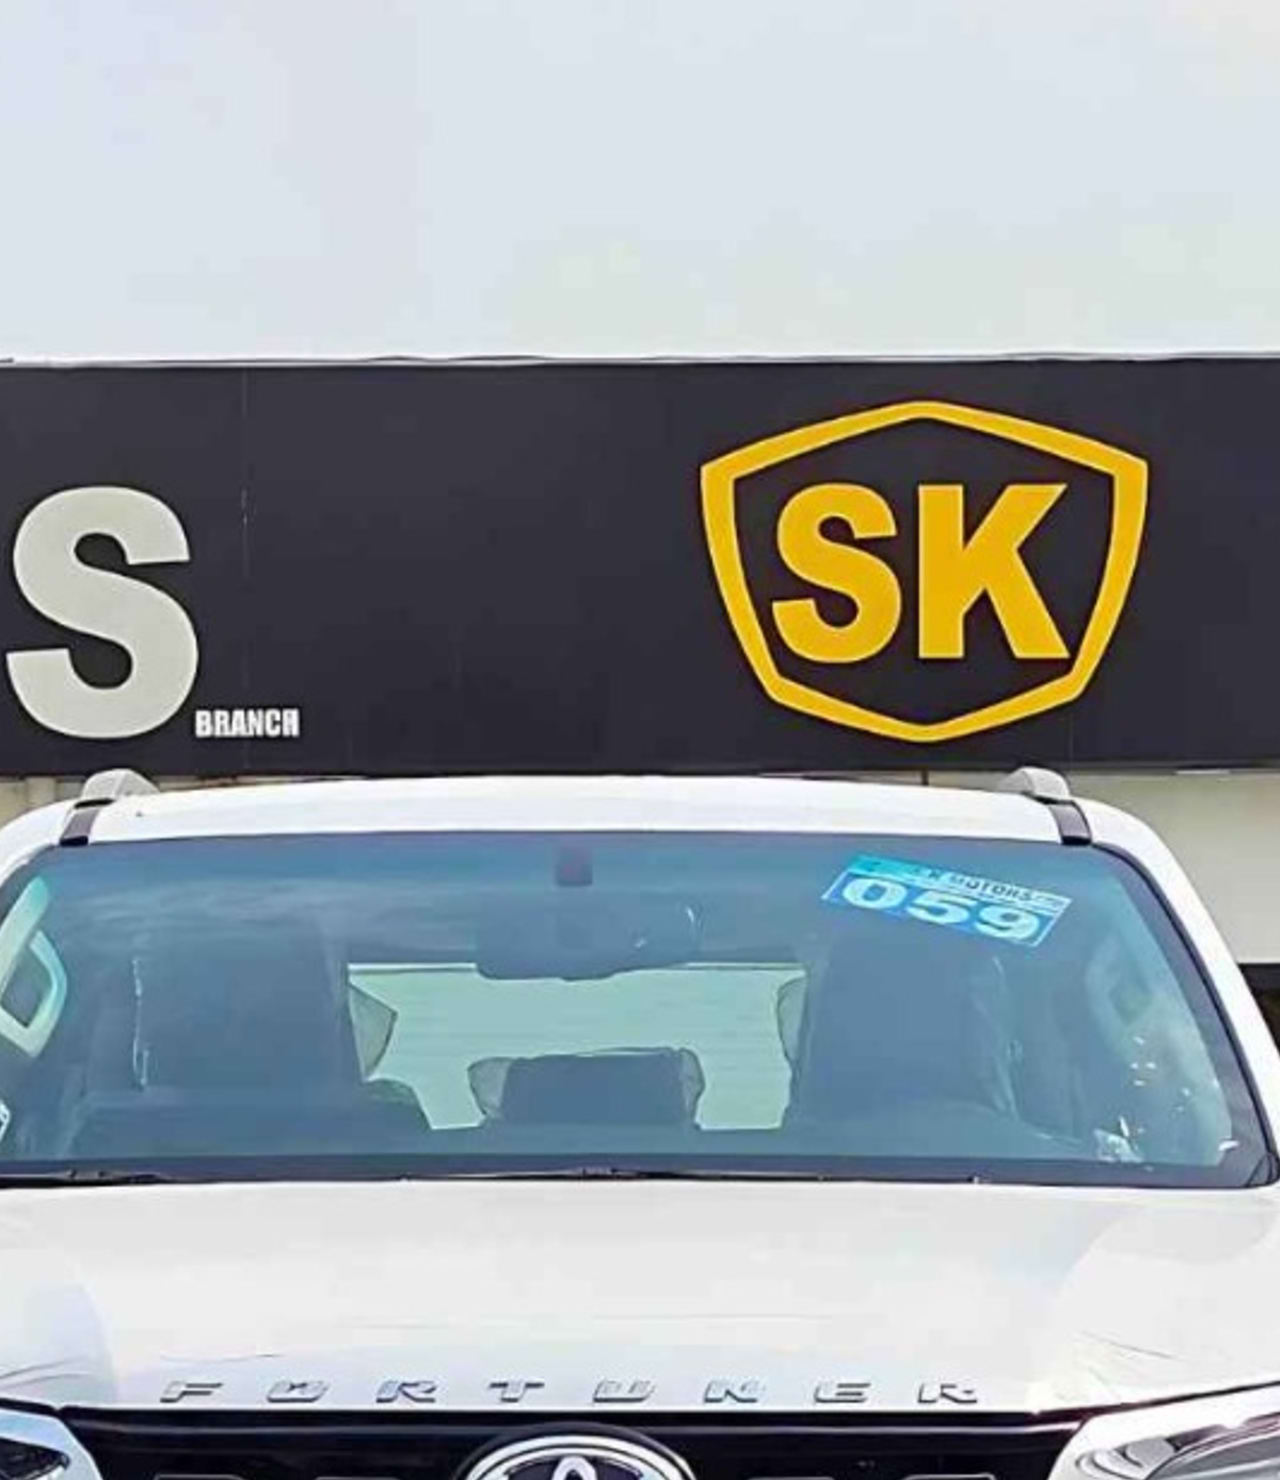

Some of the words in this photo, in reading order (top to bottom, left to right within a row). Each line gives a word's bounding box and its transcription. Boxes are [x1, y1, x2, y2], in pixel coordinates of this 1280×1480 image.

[771, 482, 1070, 664] SK
[195, 708, 300, 738] BRANCH
[841, 876, 1041, 941] 059
[159, 1378, 979, 1404] FORTUNER
